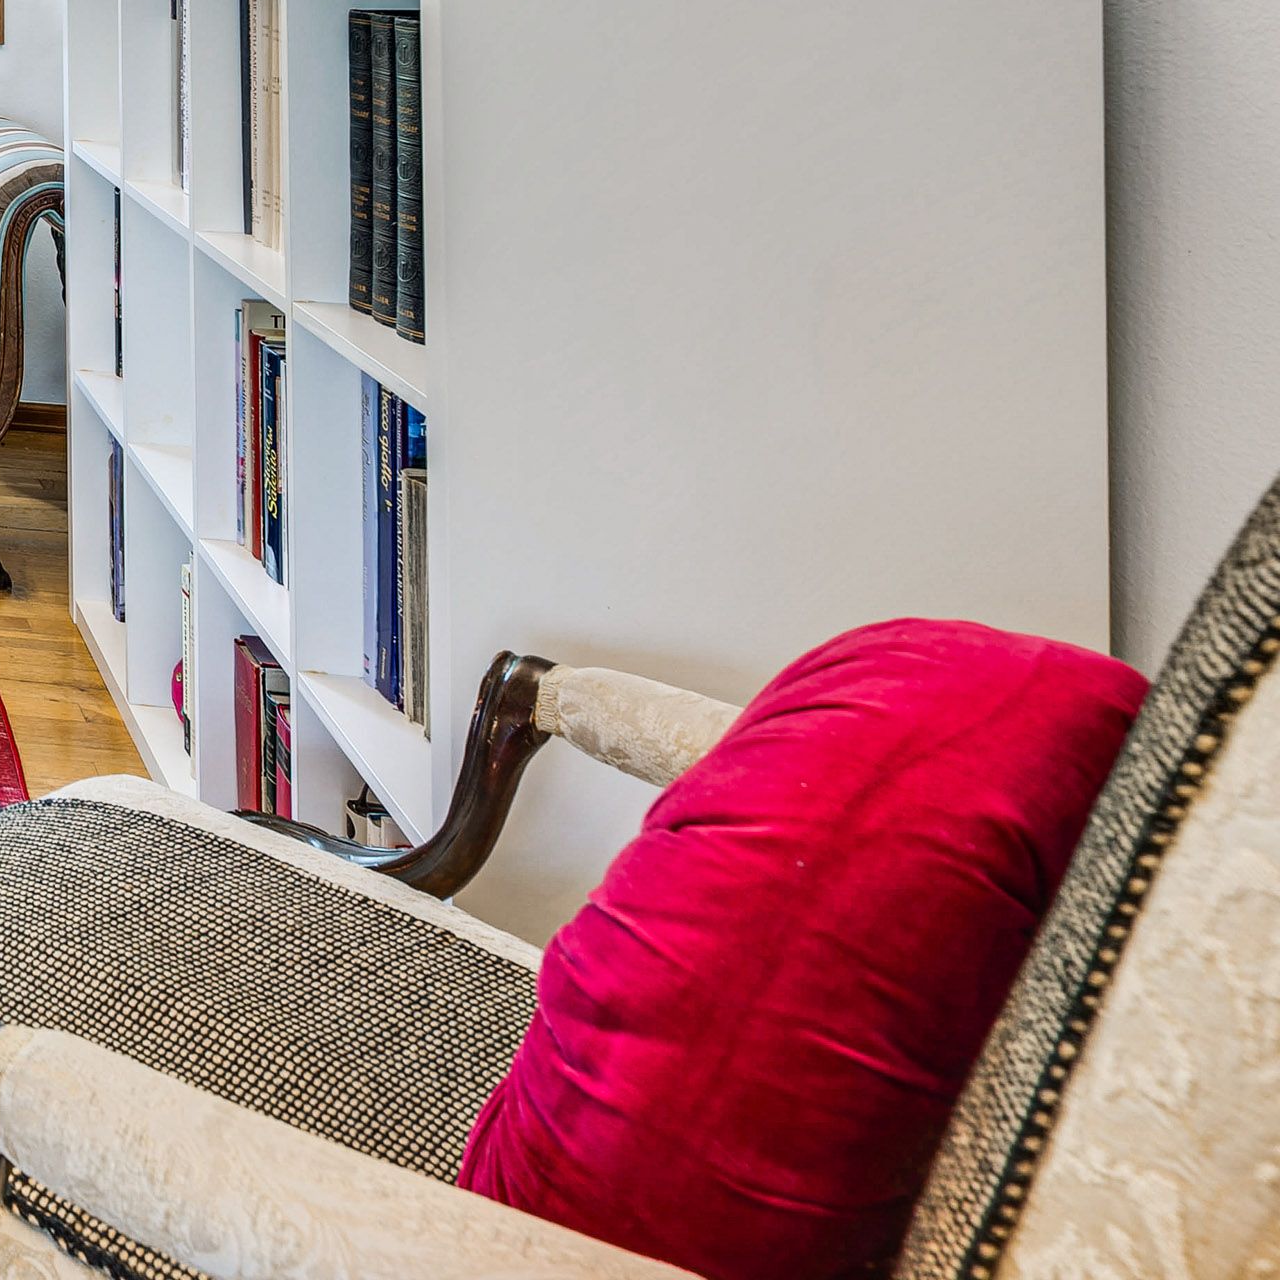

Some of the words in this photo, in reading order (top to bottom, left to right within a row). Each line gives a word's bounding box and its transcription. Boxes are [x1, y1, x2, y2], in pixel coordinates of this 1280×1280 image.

[381, 391, 392, 432] becco
[267, 449, 278, 519] Salento
[379, 435, 392, 491] giallo
[396, 558, 404, 617] GARDEN
